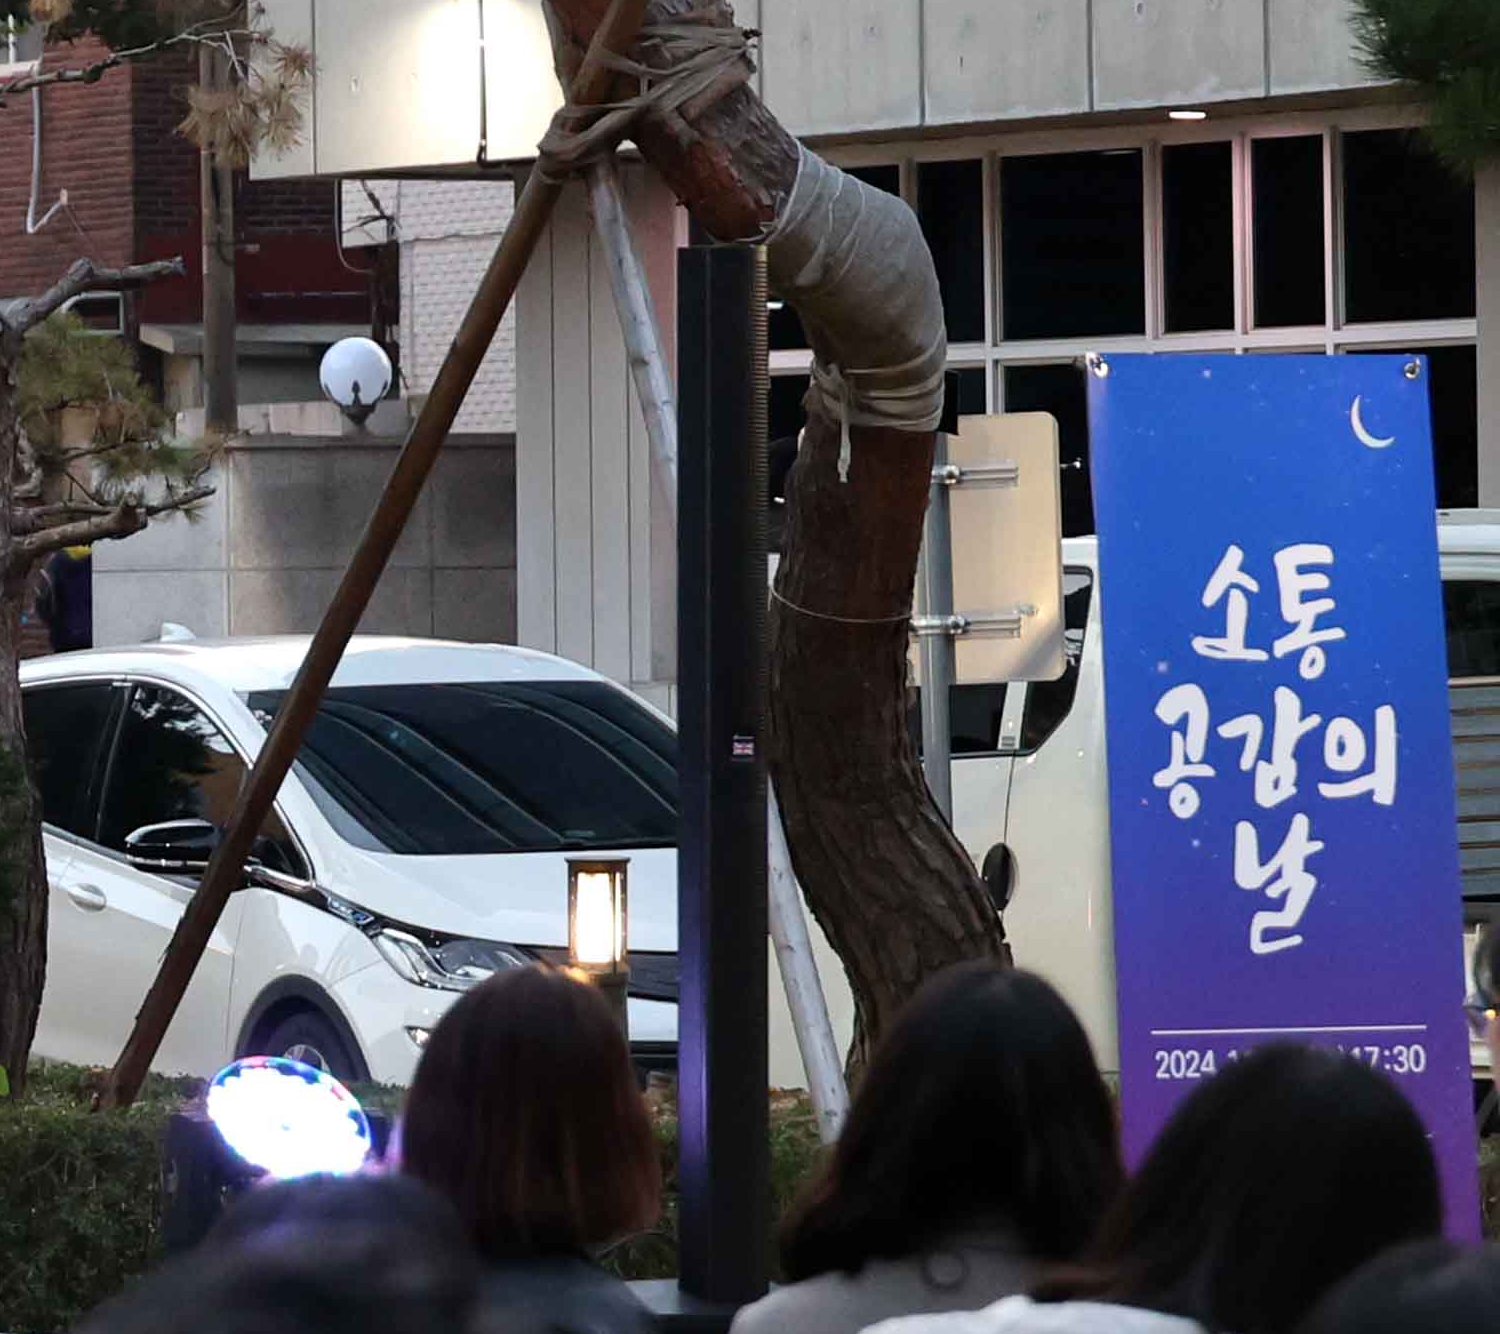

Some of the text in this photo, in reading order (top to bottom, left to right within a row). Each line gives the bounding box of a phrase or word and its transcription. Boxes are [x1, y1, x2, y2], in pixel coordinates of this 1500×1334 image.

[1191, 543, 1346, 680] 소통
[1152, 682, 1398, 819] 공감의
[1233, 812, 1324, 955] 날
